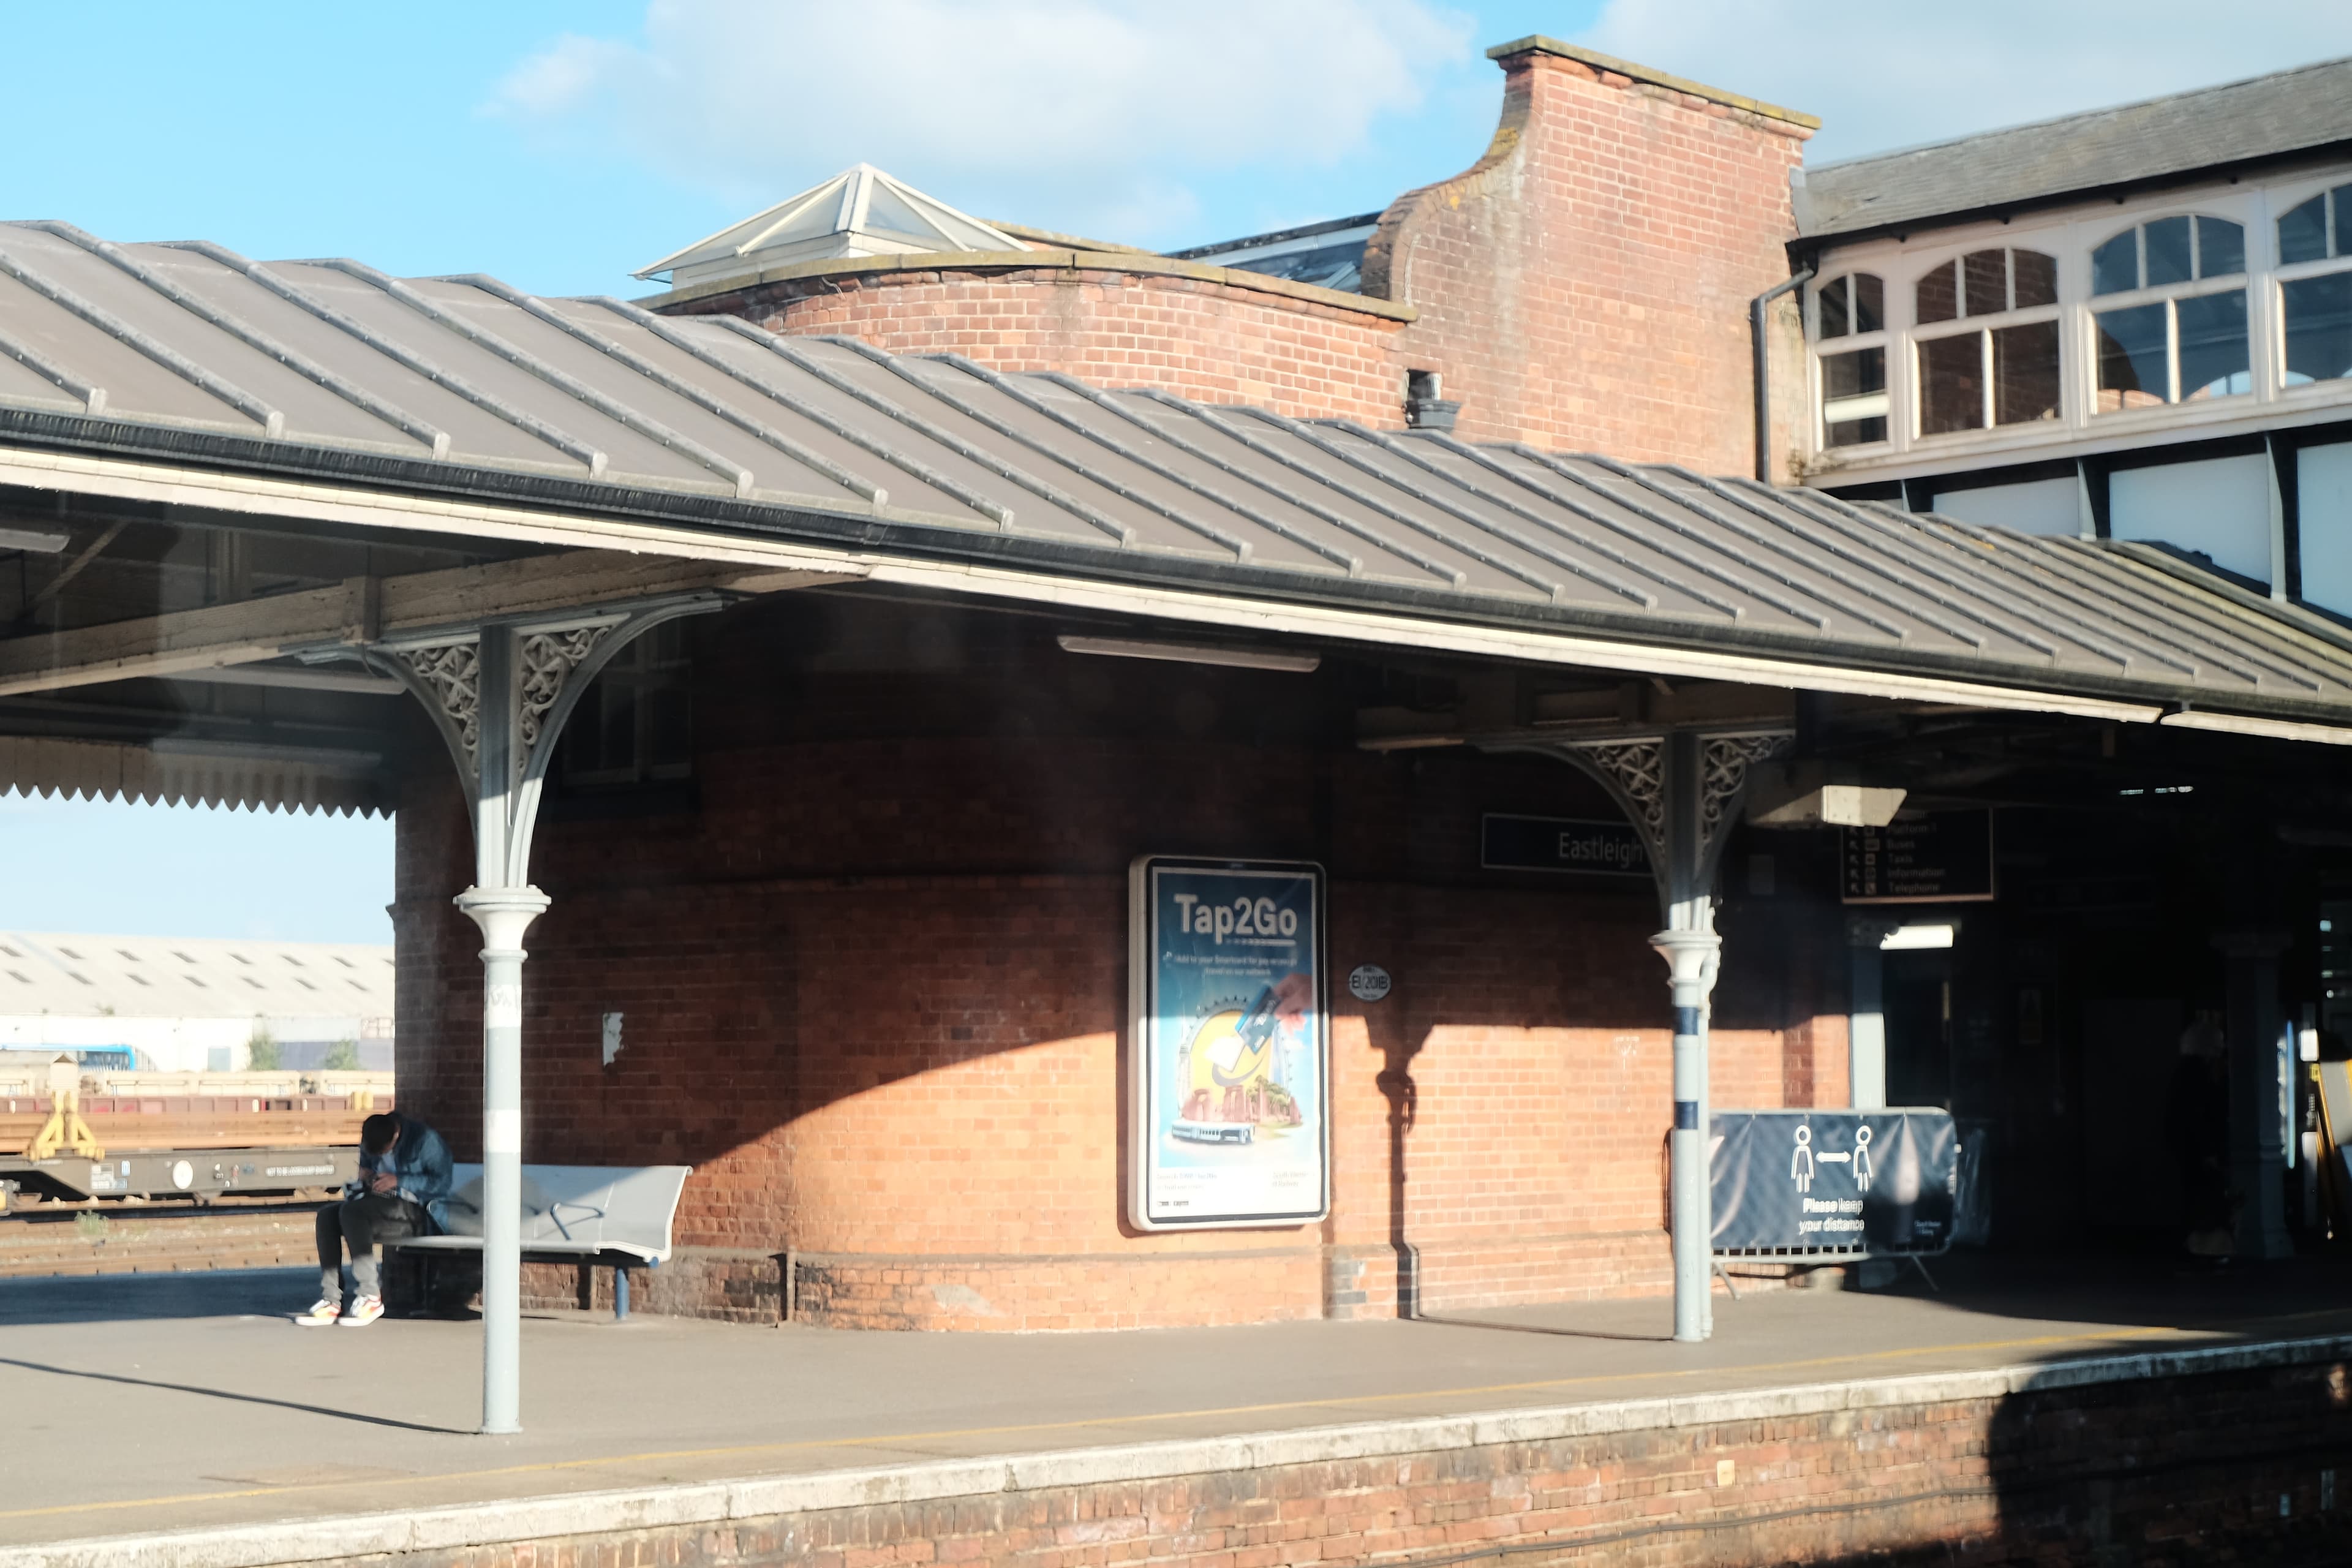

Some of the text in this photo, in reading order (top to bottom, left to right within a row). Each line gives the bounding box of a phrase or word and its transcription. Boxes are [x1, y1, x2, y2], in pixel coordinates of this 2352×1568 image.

[1559, 832, 1643, 869] Eastleigh
[1887, 867, 1946, 878] Information
[1174, 893, 1297, 945] Tap2Go
[1803, 1197, 1863, 1215] Please keep
[1799, 1216, 1864, 1235] your distance
